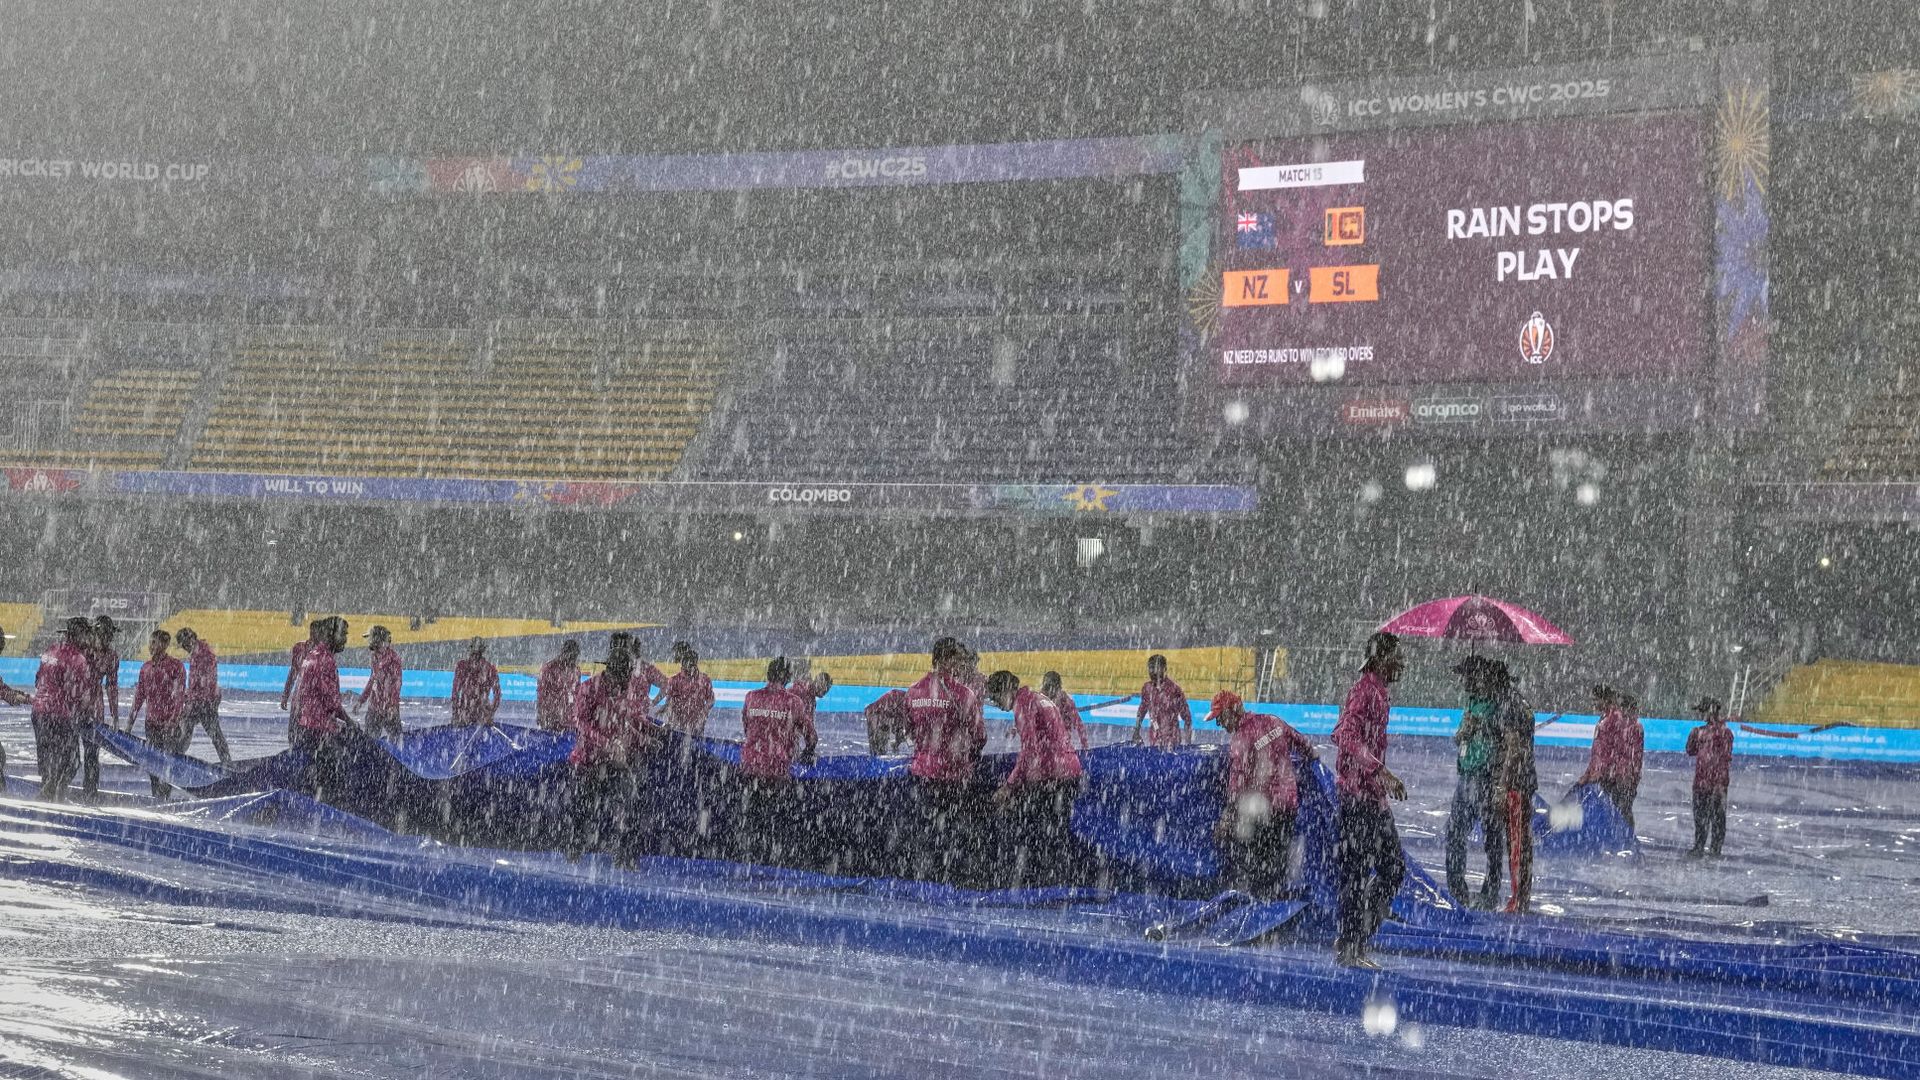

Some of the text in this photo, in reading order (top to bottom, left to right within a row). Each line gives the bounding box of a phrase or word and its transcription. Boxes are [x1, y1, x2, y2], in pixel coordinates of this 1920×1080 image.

[1348, 80, 1610, 116] ICC WOMEN'S CWC 2025
[81, 161, 159, 180] WORLD
[166, 163, 209, 181] CUP
[825, 157, 928, 179] #CWC25
[1279, 169, 1311, 183] MATCH
[1447, 198, 1634, 239] RAIN STOPS
[1497, 247, 1580, 282] PLAY
[1243, 275, 1269, 299] NZ
[1333, 272, 1355, 296] SL
[1223, 351, 1234, 364] NZ
[1235, 350, 1254, 364] NEED
[1255, 350, 1268, 364] 259
[1269, 349, 1288, 363] RUNS
[1289, 349, 1298, 362] TO
[1300, 348, 1314, 362] WIN
[1349, 346, 1374, 361] OVERS
[1530, 355, 1543, 364] ICC
[1350, 406, 1400, 419] Emirates
[1418, 404, 1479, 417] aramco
[264, 479, 363, 493] WILL TO WIN
[770, 489, 851, 502] COLOMBO
[932, 699, 950, 709] STAFF
